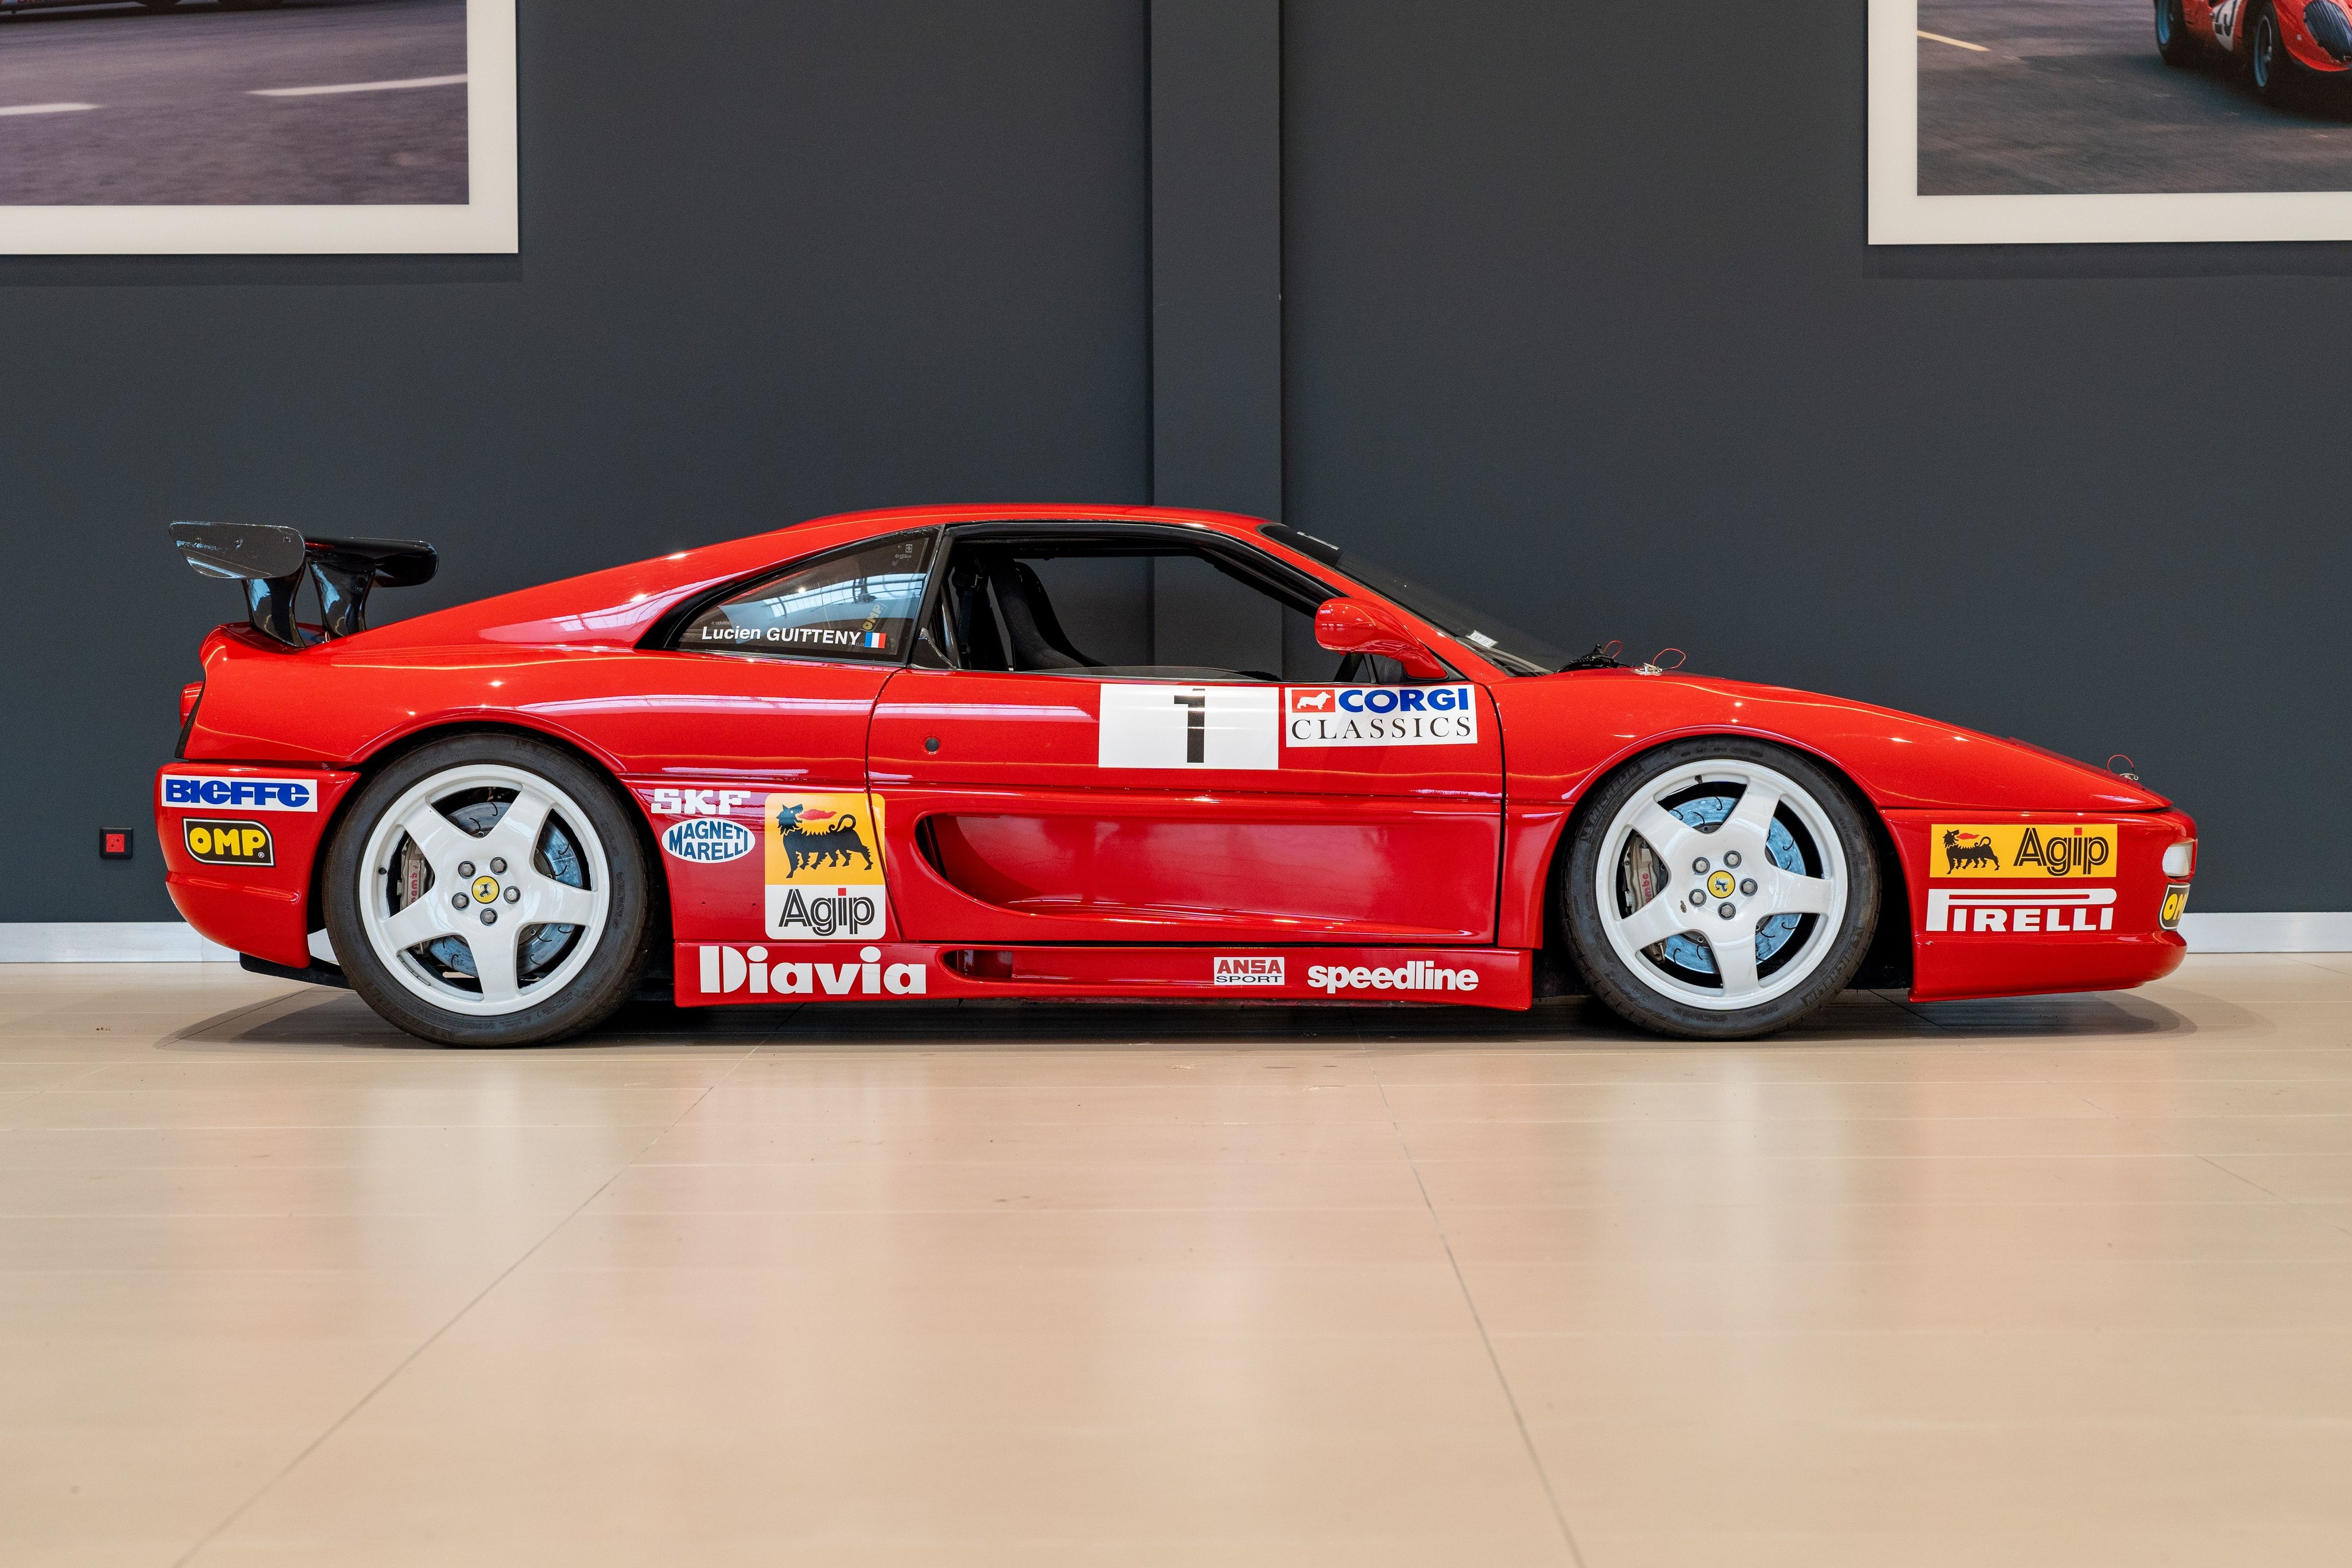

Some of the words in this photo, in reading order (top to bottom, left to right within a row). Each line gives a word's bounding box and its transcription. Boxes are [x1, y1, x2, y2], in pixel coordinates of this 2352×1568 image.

[862, 603, 882, 630] OMP
[702, 625, 761, 640] Lucien
[767, 626, 862, 646] GUITTENY
[1338, 688, 1469, 714] CORGI
[1174, 688, 1206, 764] 1
[1291, 716, 1471, 741] CLASSICS
[651, 788, 751, 815] SKF
[189, 827, 266, 856] OMP
[669, 820, 748, 847] MAGNETI
[669, 837, 748, 861] MARELLI
[2013, 827, 2110, 877] Agip
[778, 888, 875, 936] Agip
[1925, 888, 2118, 932] PIRELLI
[2163, 893, 2187, 920] OM
[699, 946, 927, 994] Diavia
[1216, 959, 1282, 974] ANSA
[1216, 975, 1283, 984] SPORT
[1307, 961, 1479, 994] speedline
